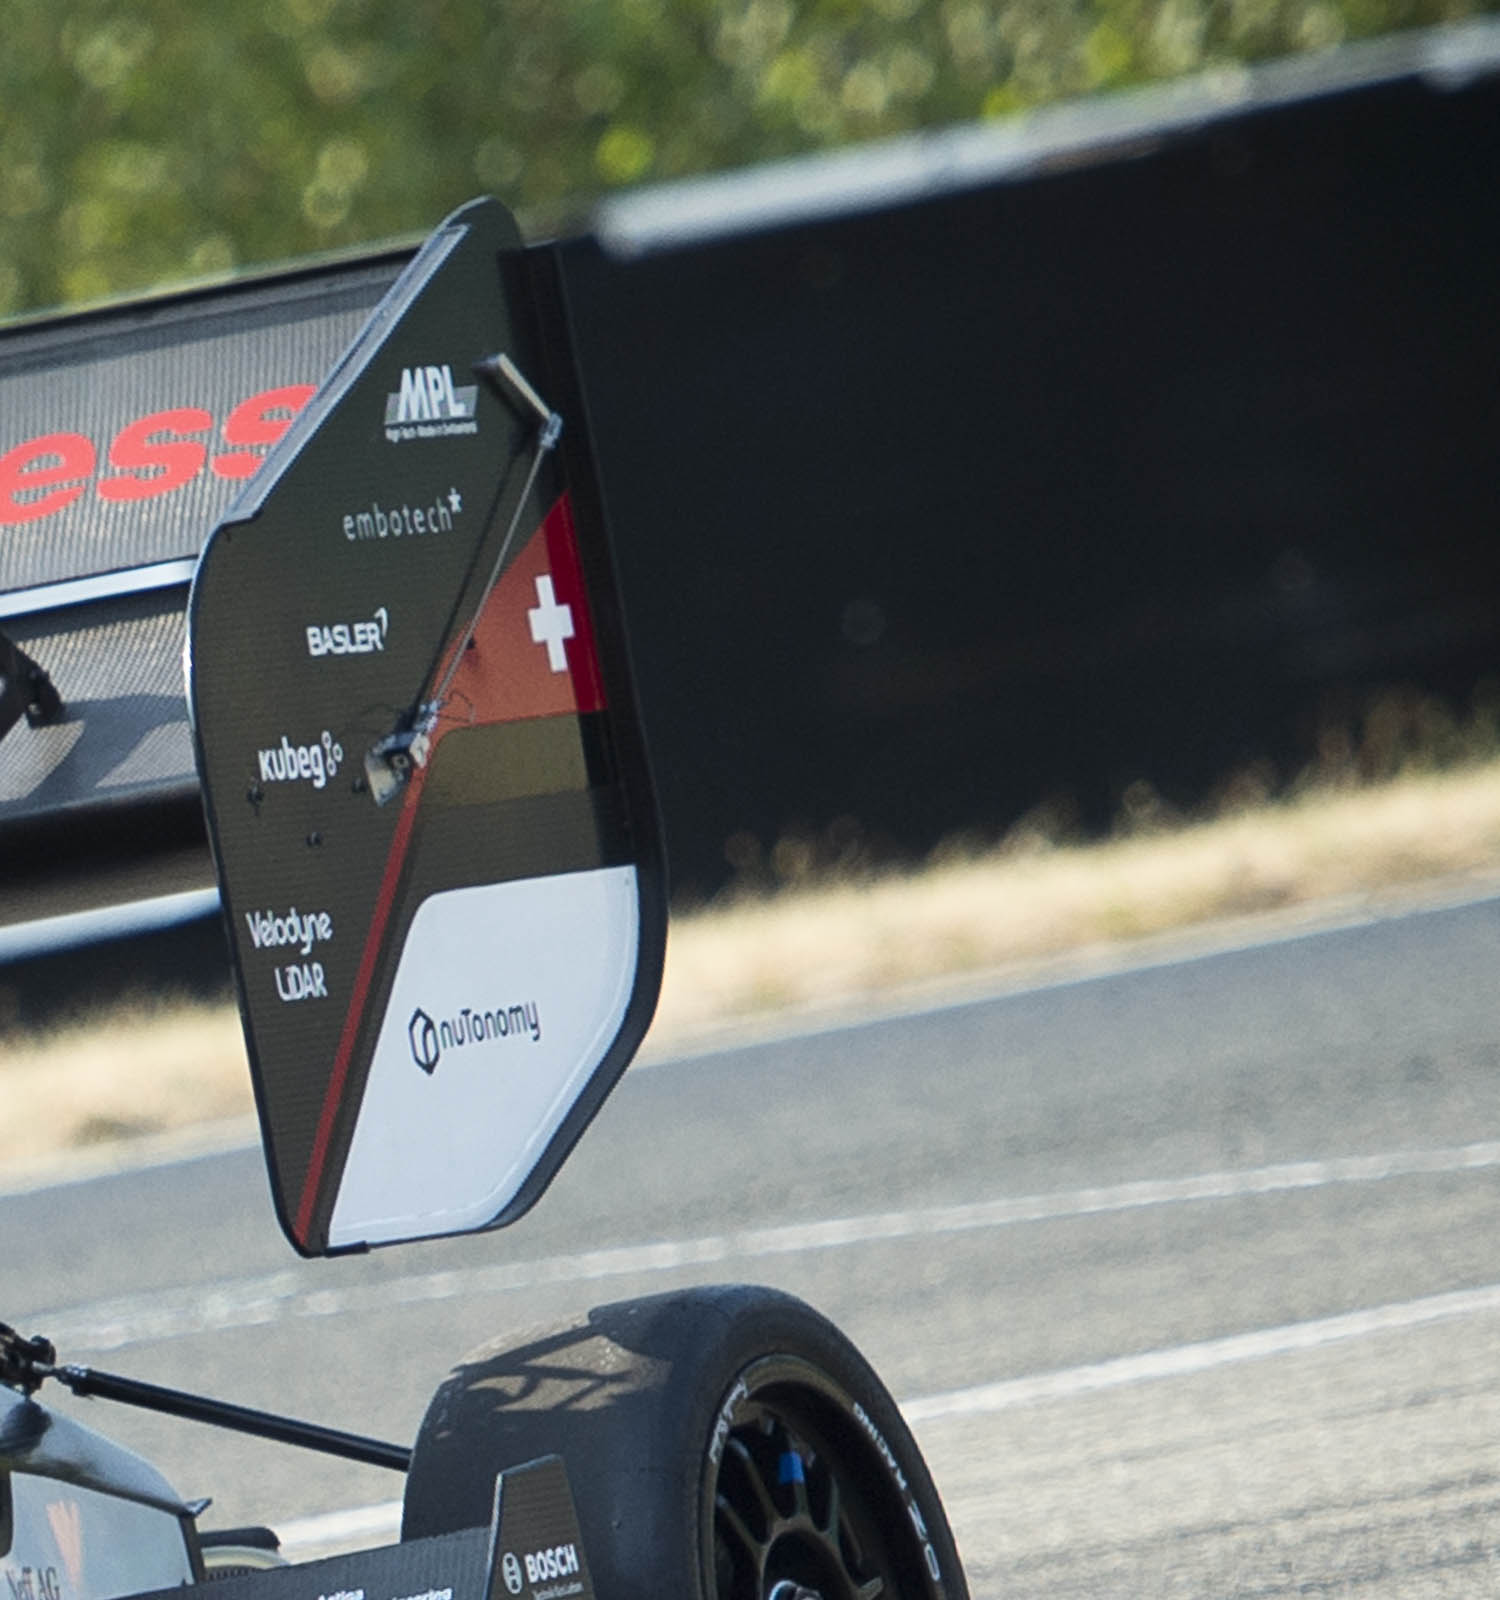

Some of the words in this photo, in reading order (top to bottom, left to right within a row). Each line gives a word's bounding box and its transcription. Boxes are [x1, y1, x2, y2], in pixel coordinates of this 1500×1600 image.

[397, 365, 467, 423] MPL
[343, 496, 454, 541] embotech
[306, 621, 384, 656] BASLER
[258, 735, 328, 788] kubeg
[245, 906, 334, 955] Velodyne
[439, 1001, 541, 1050] nuTonomy
[524, 1545, 580, 1584] BOSCH
